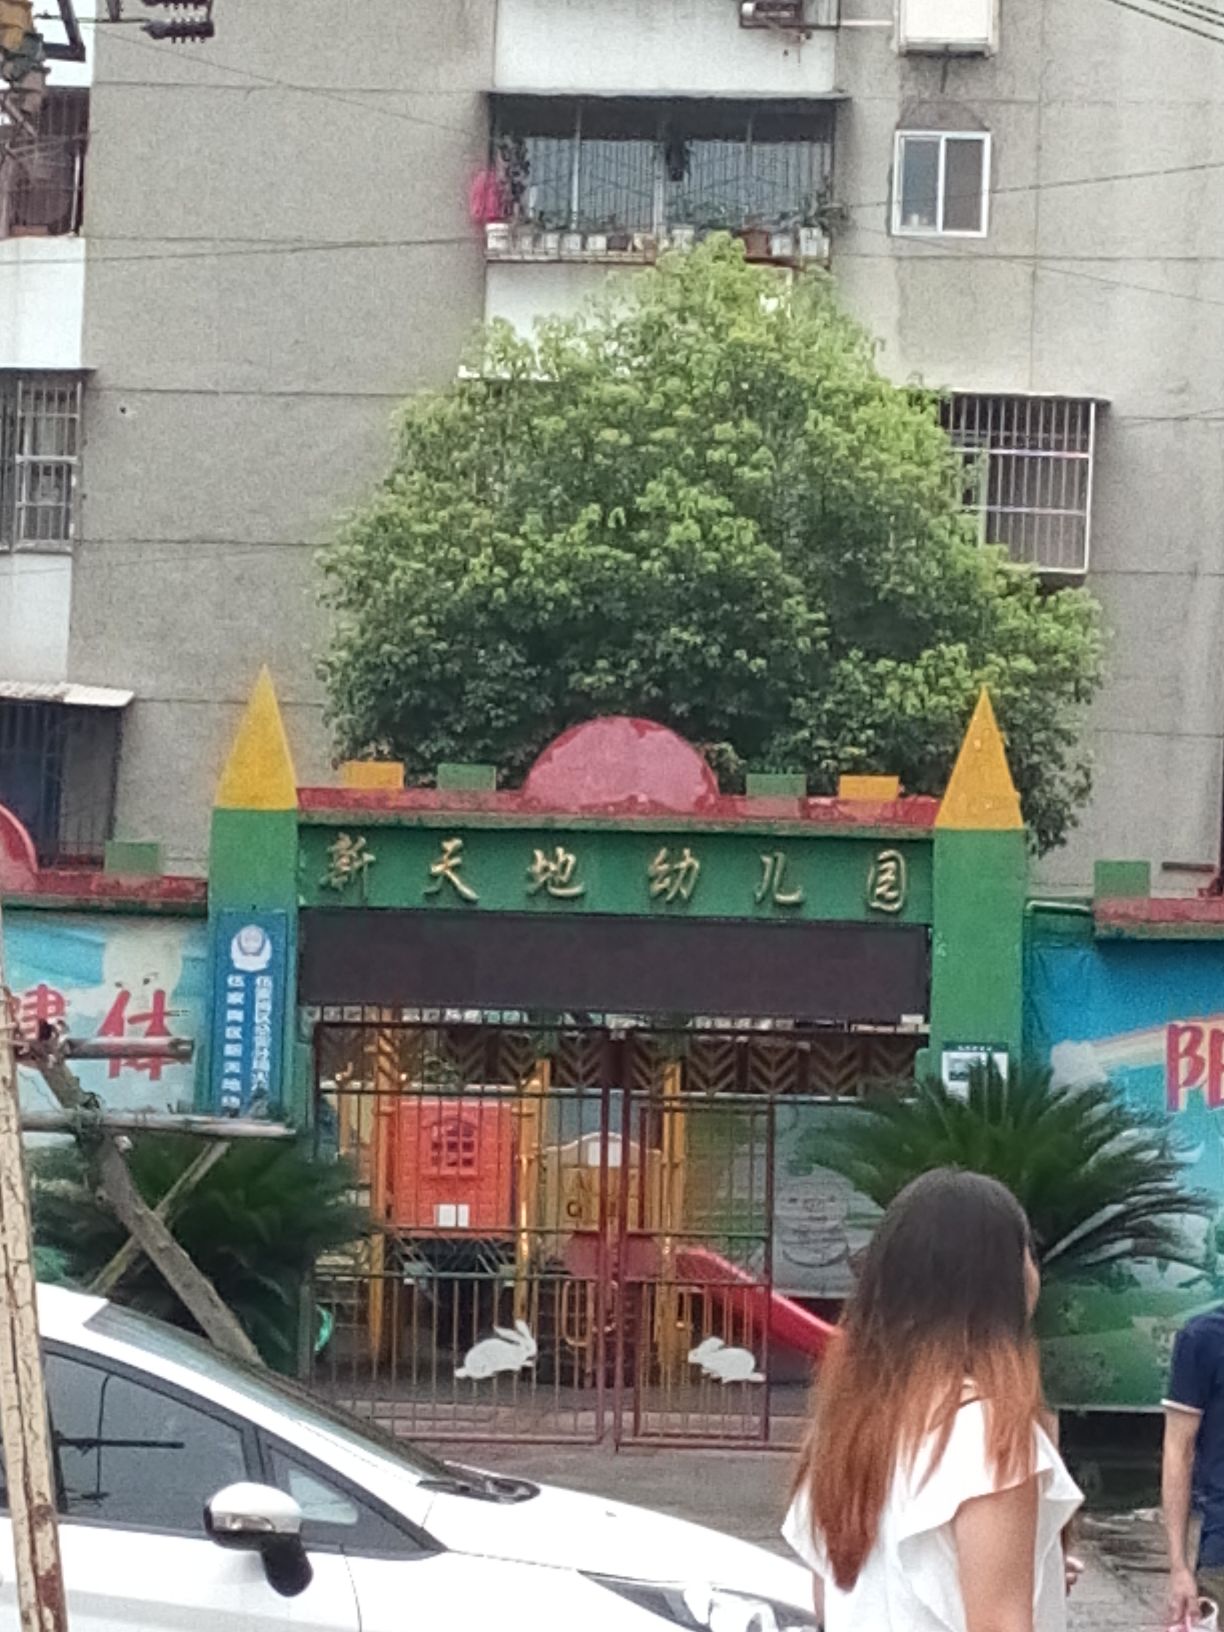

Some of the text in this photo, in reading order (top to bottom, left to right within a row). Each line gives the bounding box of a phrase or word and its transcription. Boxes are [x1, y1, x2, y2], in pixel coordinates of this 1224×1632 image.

[320, 832, 906, 911] 新天地幼儿园
